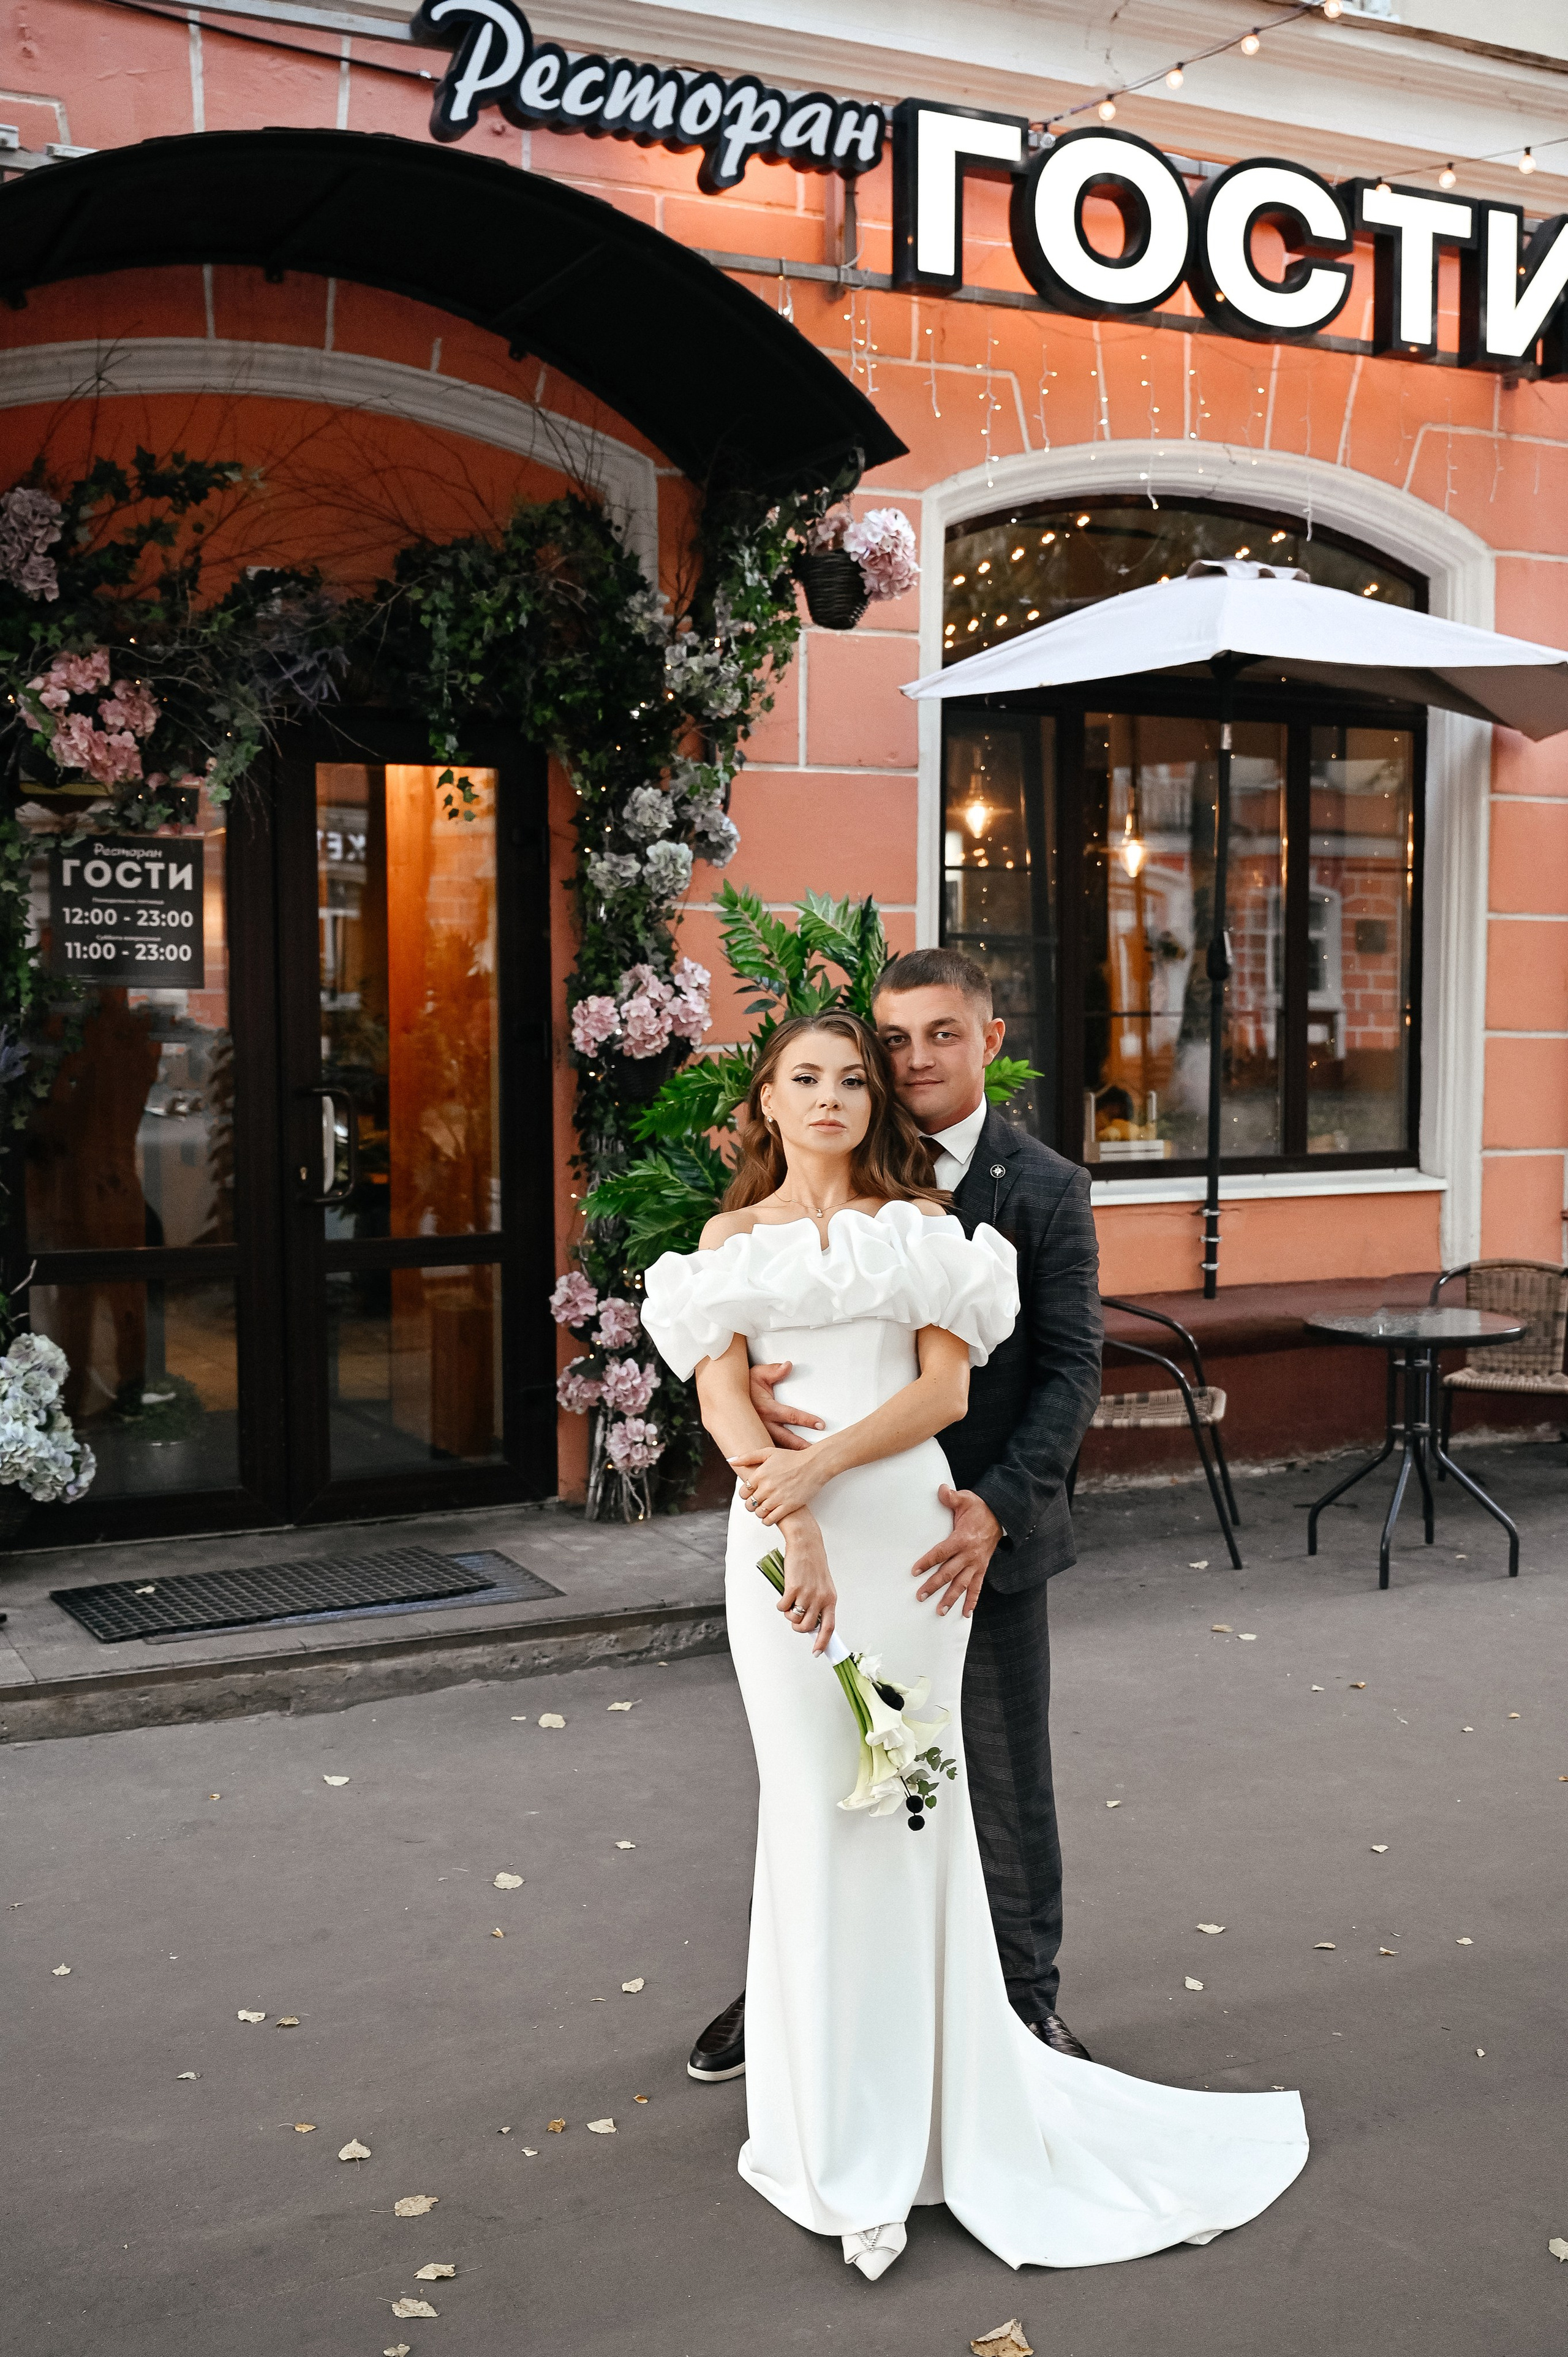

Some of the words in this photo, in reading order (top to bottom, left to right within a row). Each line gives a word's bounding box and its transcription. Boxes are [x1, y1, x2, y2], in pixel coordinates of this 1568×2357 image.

[430, 0, 880, 178] Ресторан
[918, 109, 1568, 357] ГОСТИ
[94, 842, 163, 860] Ресторан
[62, 859, 193, 890] ГОСТИ
[62, 907, 117, 925] 12:00
[136, 909, 194, 928] 23:00
[65, 942, 116, 960] 11:00
[134, 944, 192, 961] 23:00
